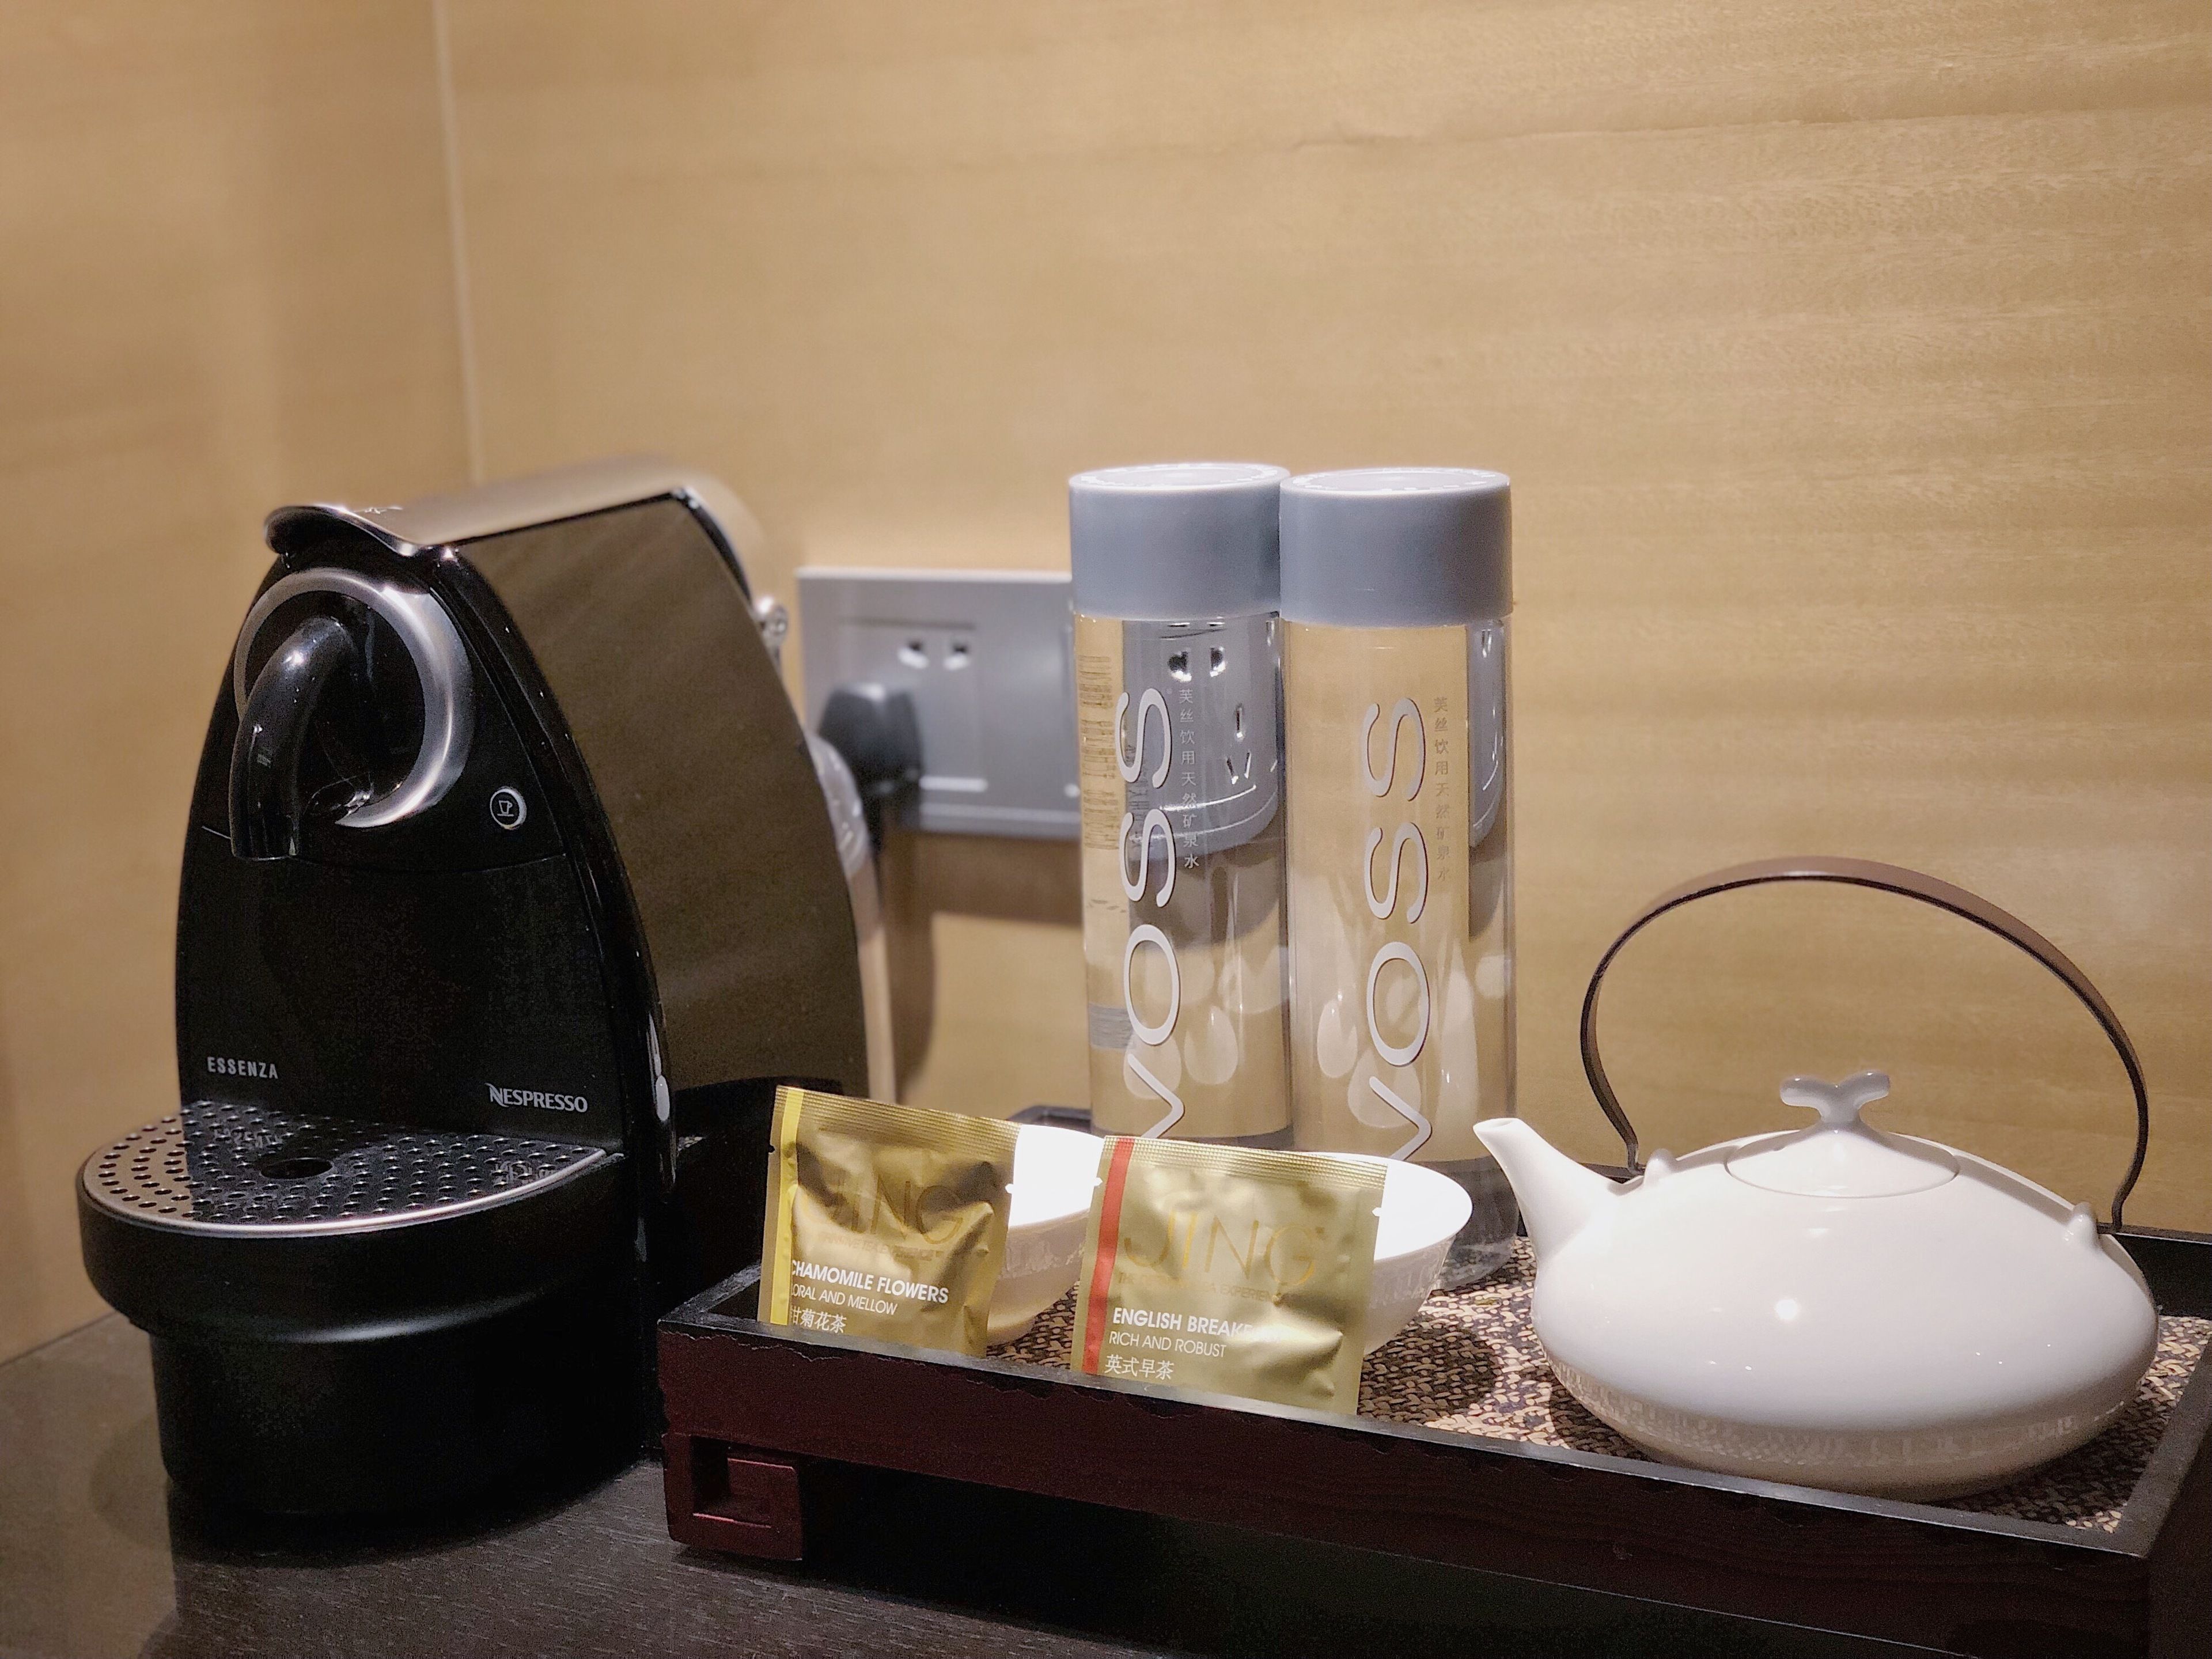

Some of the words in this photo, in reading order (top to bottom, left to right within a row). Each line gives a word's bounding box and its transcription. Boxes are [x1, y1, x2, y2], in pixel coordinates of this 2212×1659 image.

[1115, 688, 1184, 1138] VOSS
[1361, 698, 1433, 1160] VOSS
[207, 1056, 278, 1079] ESSENZA
[484, 1083, 588, 1113] NESPRESSO
[791, 1283, 816, 1301] ORAL
[819, 1289, 846, 1305] AND
[847, 1295, 899, 1315] MELLOW
[877, 1277, 949, 1304] FLOWERS
[791, 1306, 847, 1334] 甘菊花茶
[1112, 1307, 1182, 1331] ENGLISH
[1187, 1316, 1257, 1338] BREAKF
[1109, 1331, 1139, 1346] RICH
[1142, 1335, 1172, 1351] AND
[1175, 1339, 1227, 1358] ROBUST
[1104, 1354, 1175, 1380] 英式早茶
